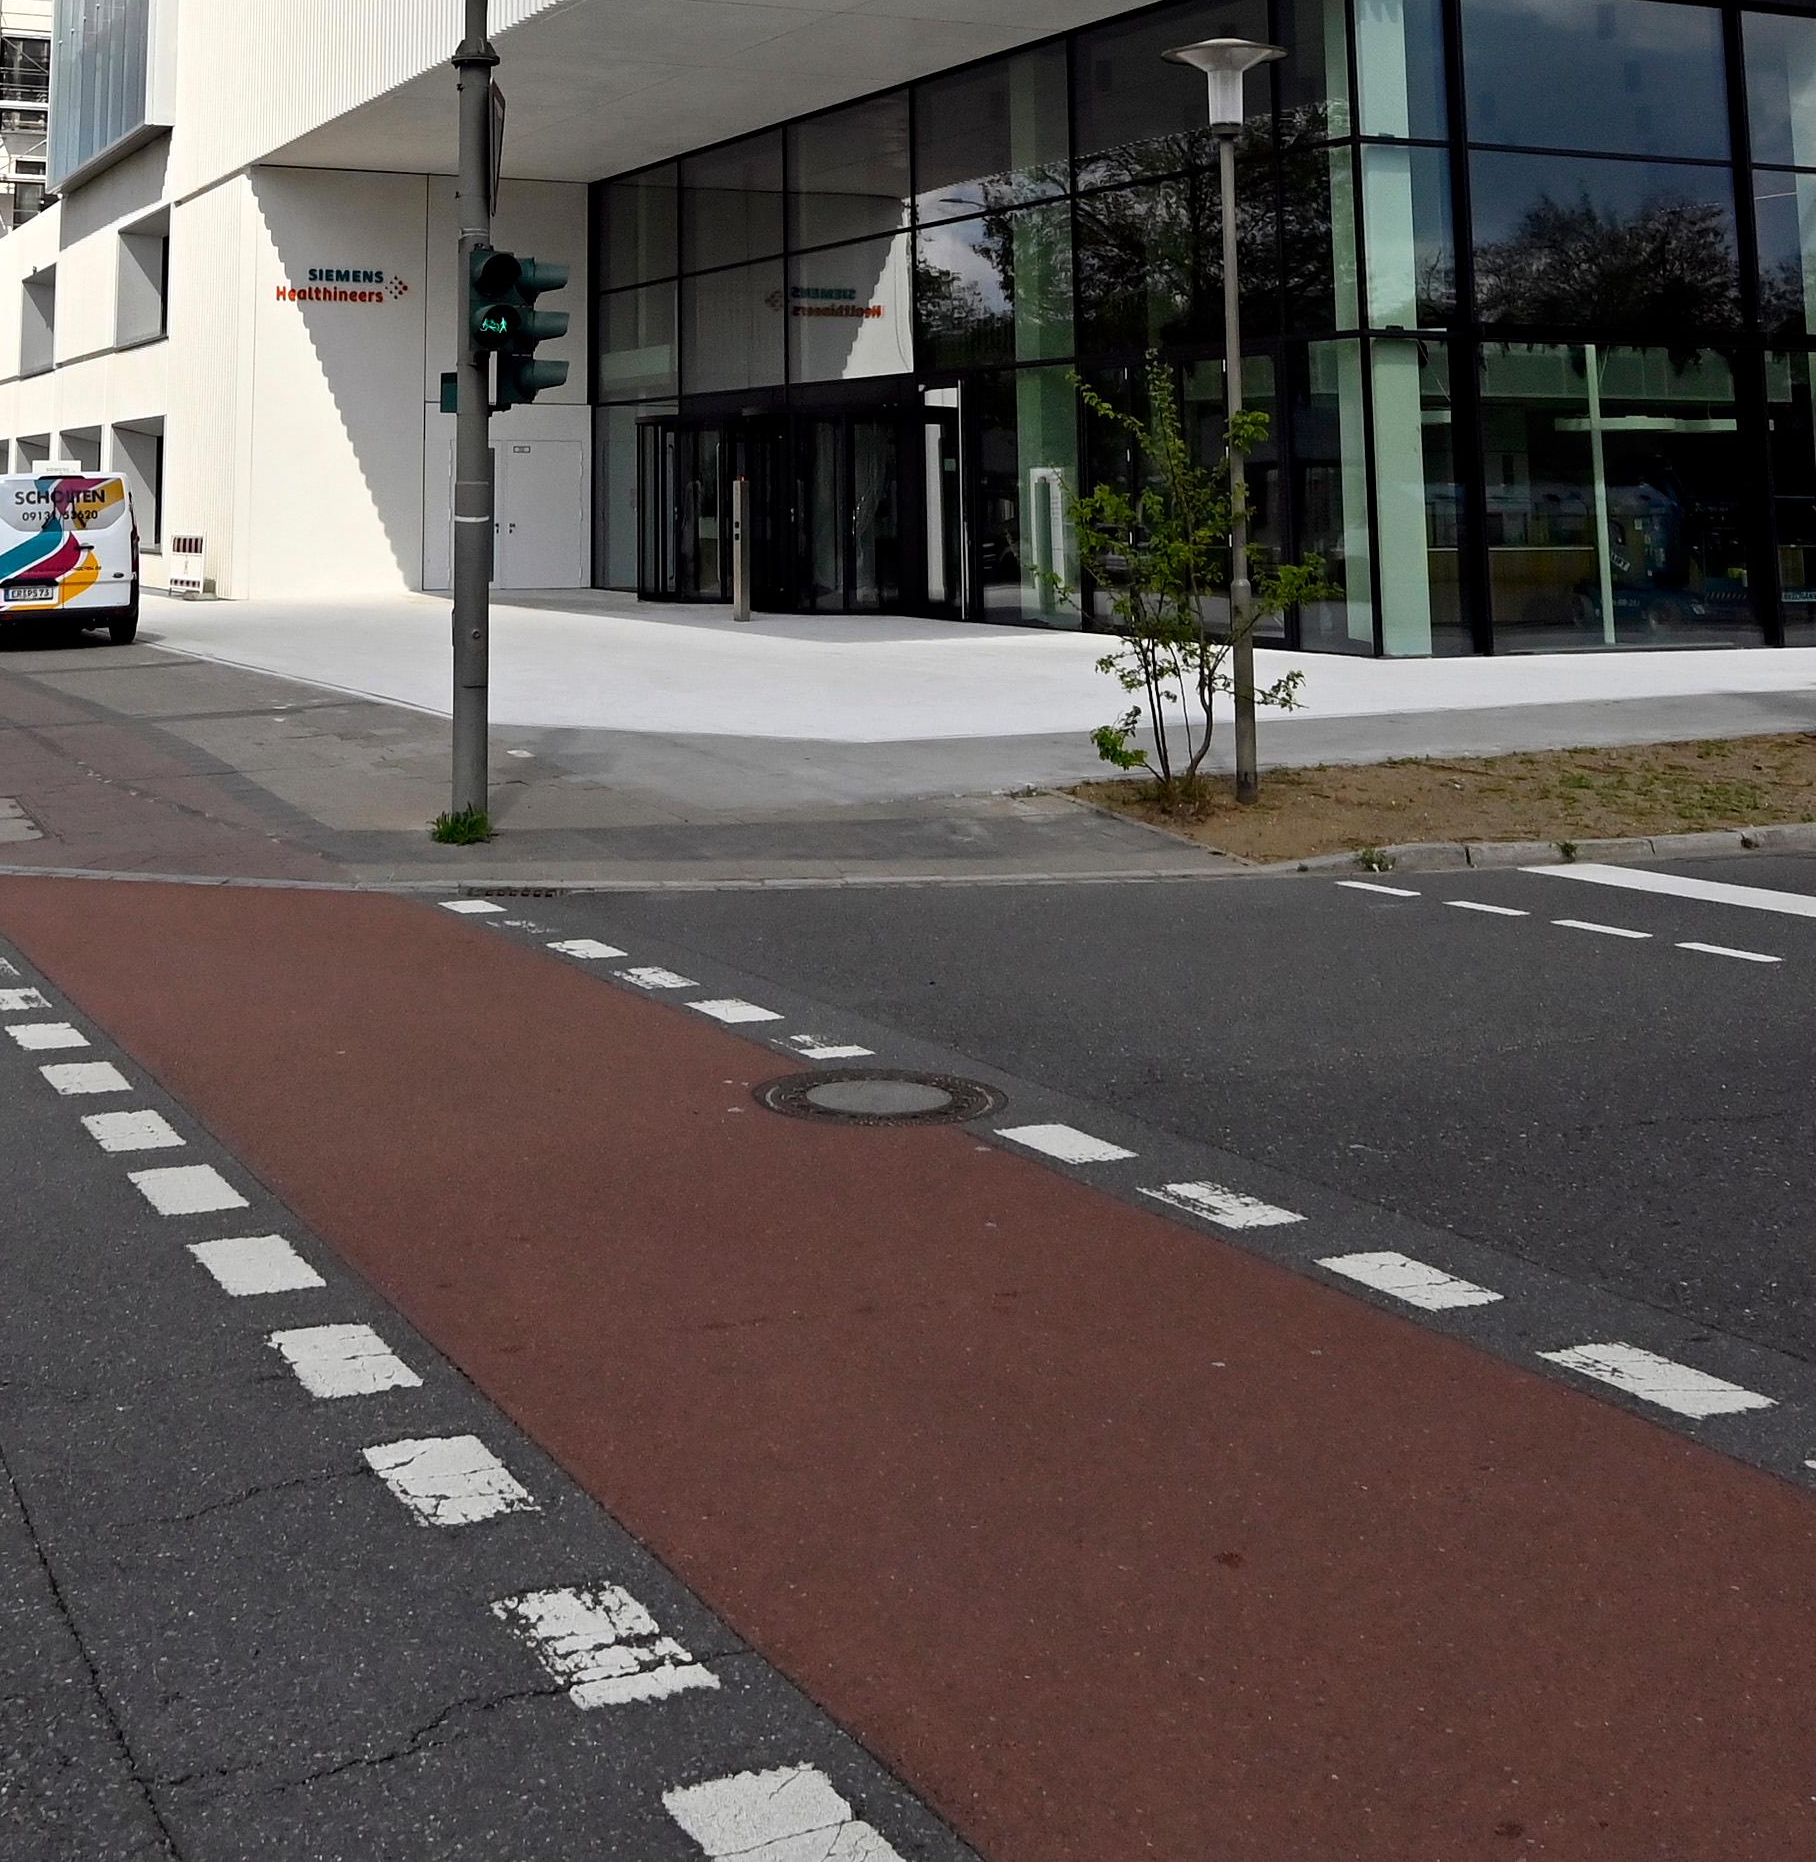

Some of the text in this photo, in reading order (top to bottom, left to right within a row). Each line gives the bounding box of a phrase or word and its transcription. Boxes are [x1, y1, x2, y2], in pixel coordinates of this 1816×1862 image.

[308, 268, 384, 284] SIEMENS
[276, 285, 384, 303] Healthineers
[14, 489, 105, 505] SCHOLTEN
